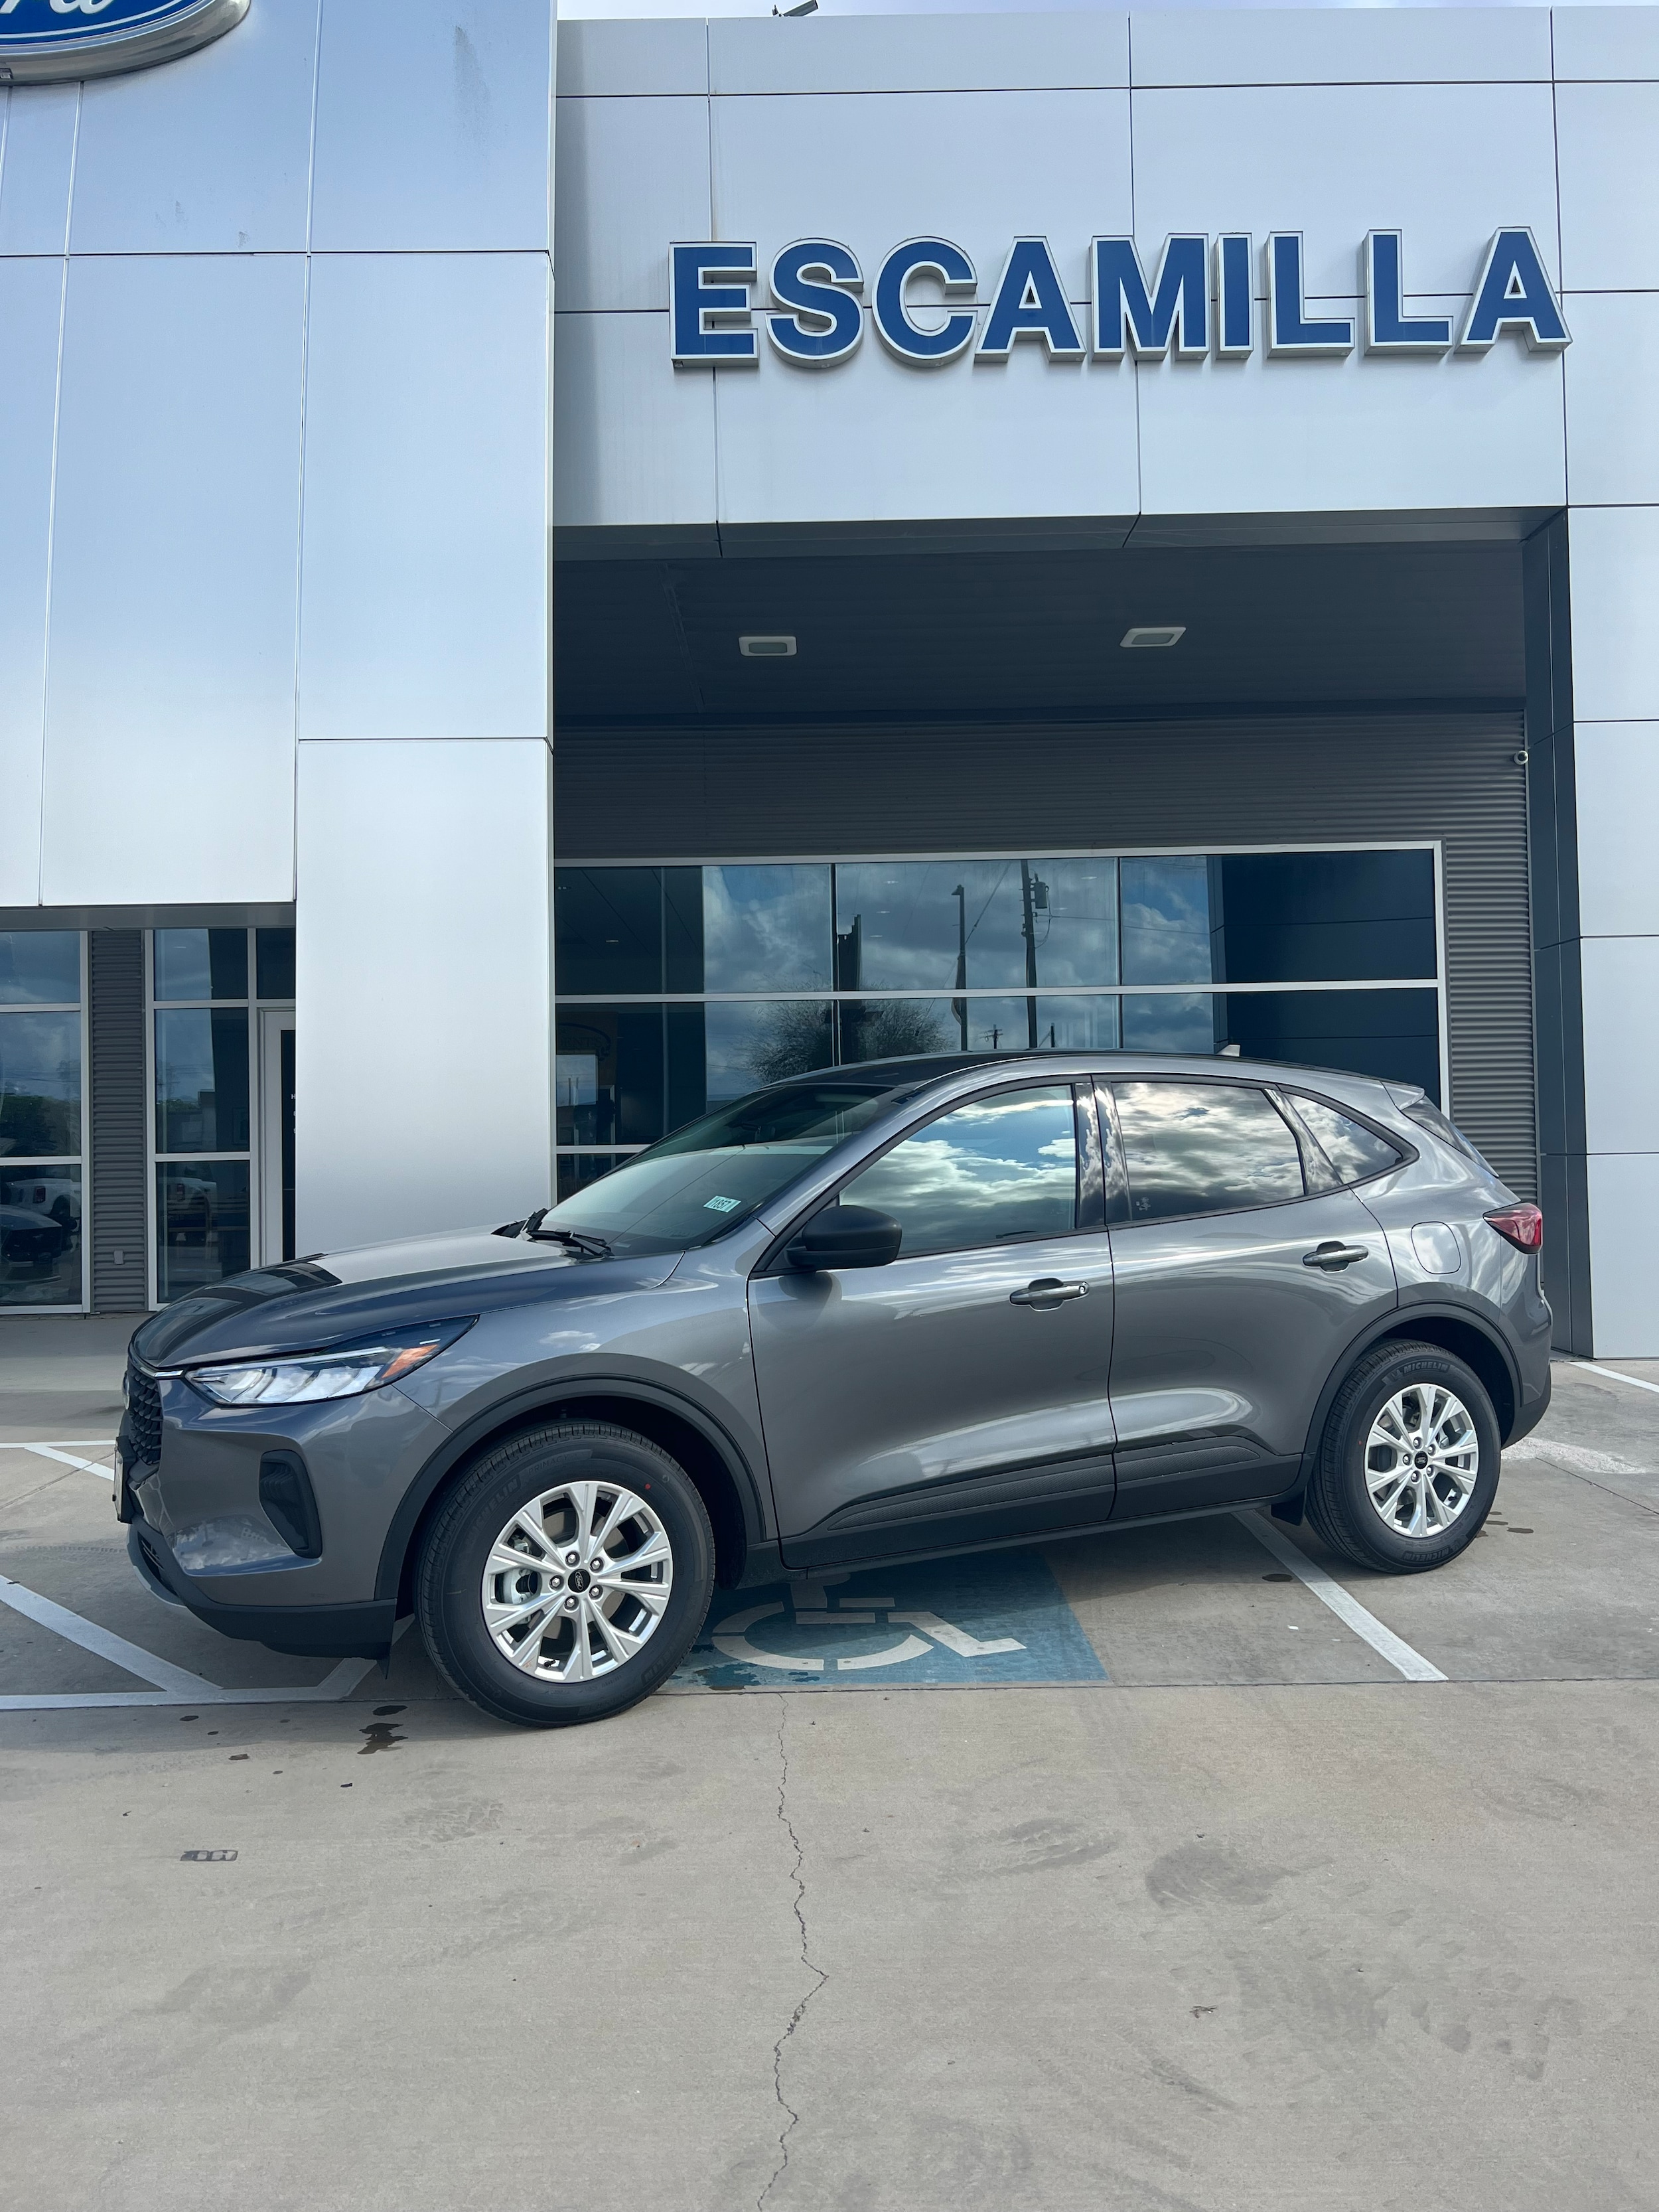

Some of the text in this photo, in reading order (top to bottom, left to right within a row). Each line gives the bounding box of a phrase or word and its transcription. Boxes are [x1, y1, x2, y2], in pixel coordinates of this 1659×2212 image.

[670, 226, 1573, 369] ESCAMILLA
[1404, 1361, 1449, 1374] MICHELIN
[528, 1454, 569, 1475] PRIMACY
[1404, 1547, 1450, 1562] MICHELIN
